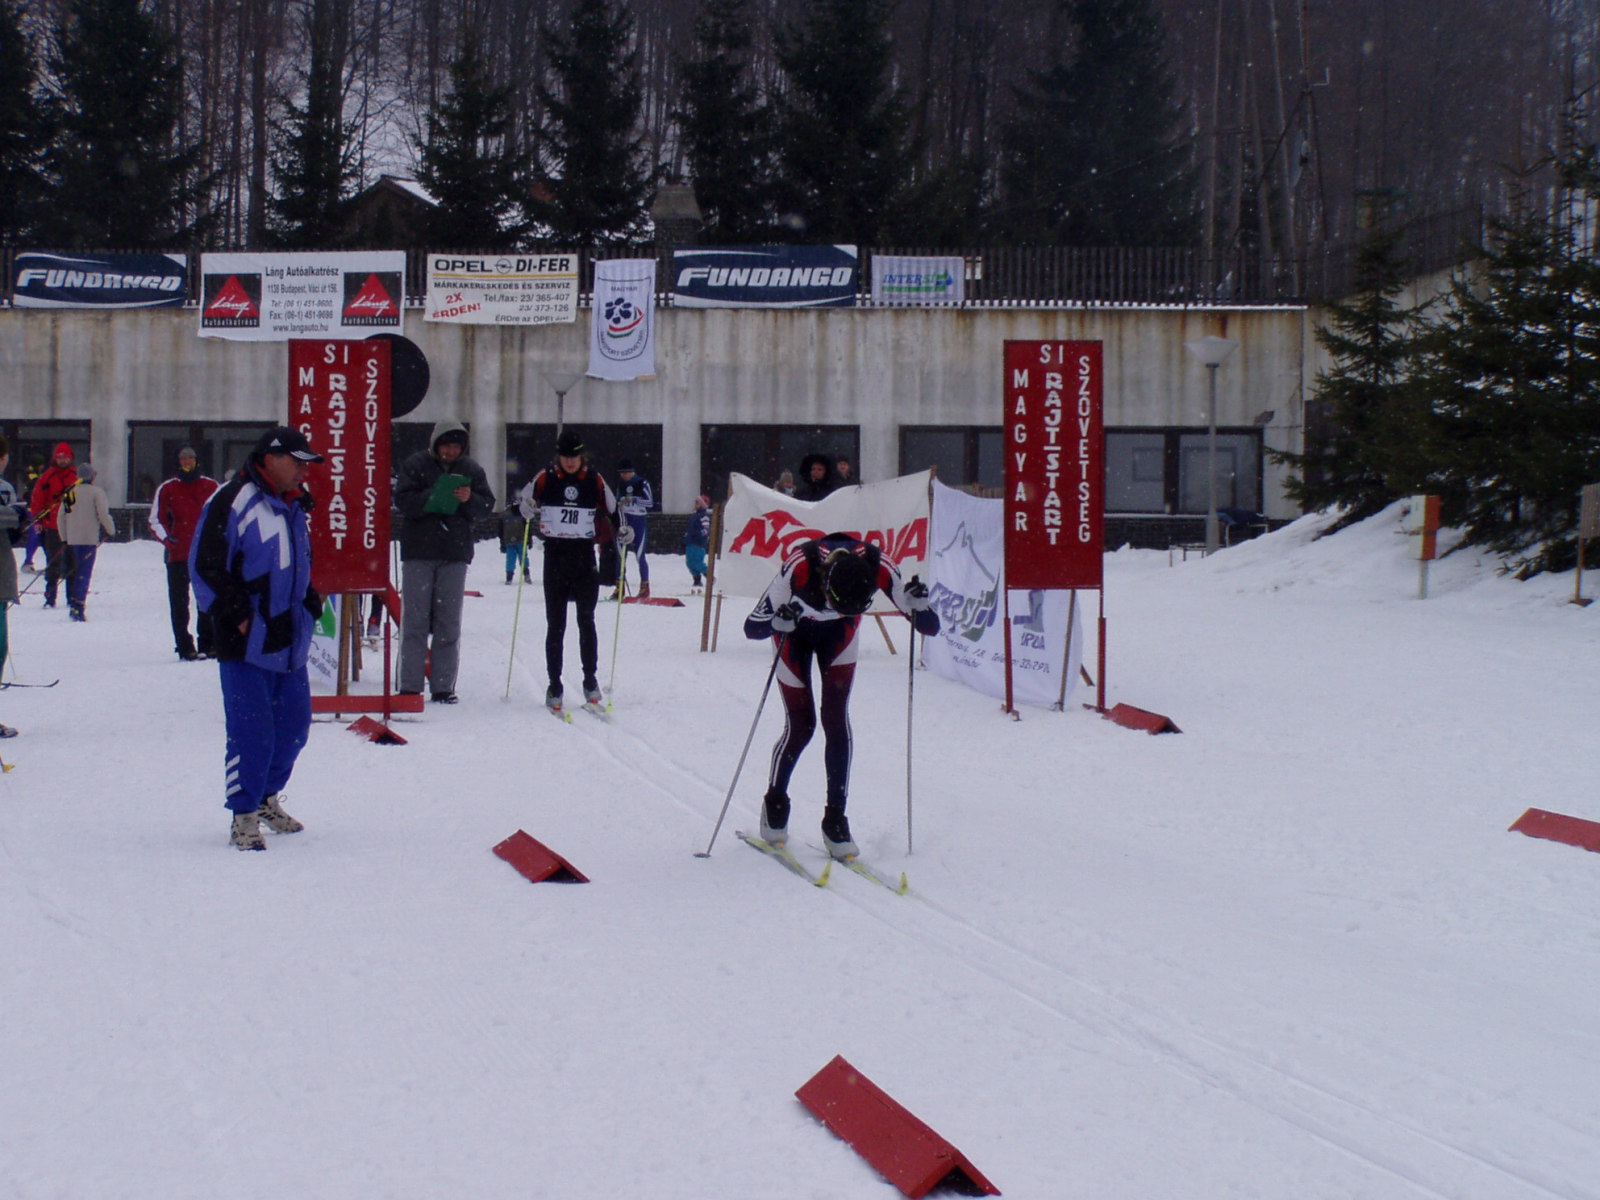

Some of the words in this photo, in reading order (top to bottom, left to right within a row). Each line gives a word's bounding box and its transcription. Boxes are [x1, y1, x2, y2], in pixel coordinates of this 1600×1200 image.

[266, 266, 284, 279] Láng
[435, 259, 493, 273] OPEL
[515, 258, 570, 272] DI-FER
[17, 269, 182, 291] FUNDANGO
[677, 267, 852, 287] FUNDANGO
[535, 282, 570, 290] SZERVIZ
[445, 292, 463, 304] 2X
[1014, 368, 1029, 531] MAGYAR
[560, 509, 579, 525] 218
